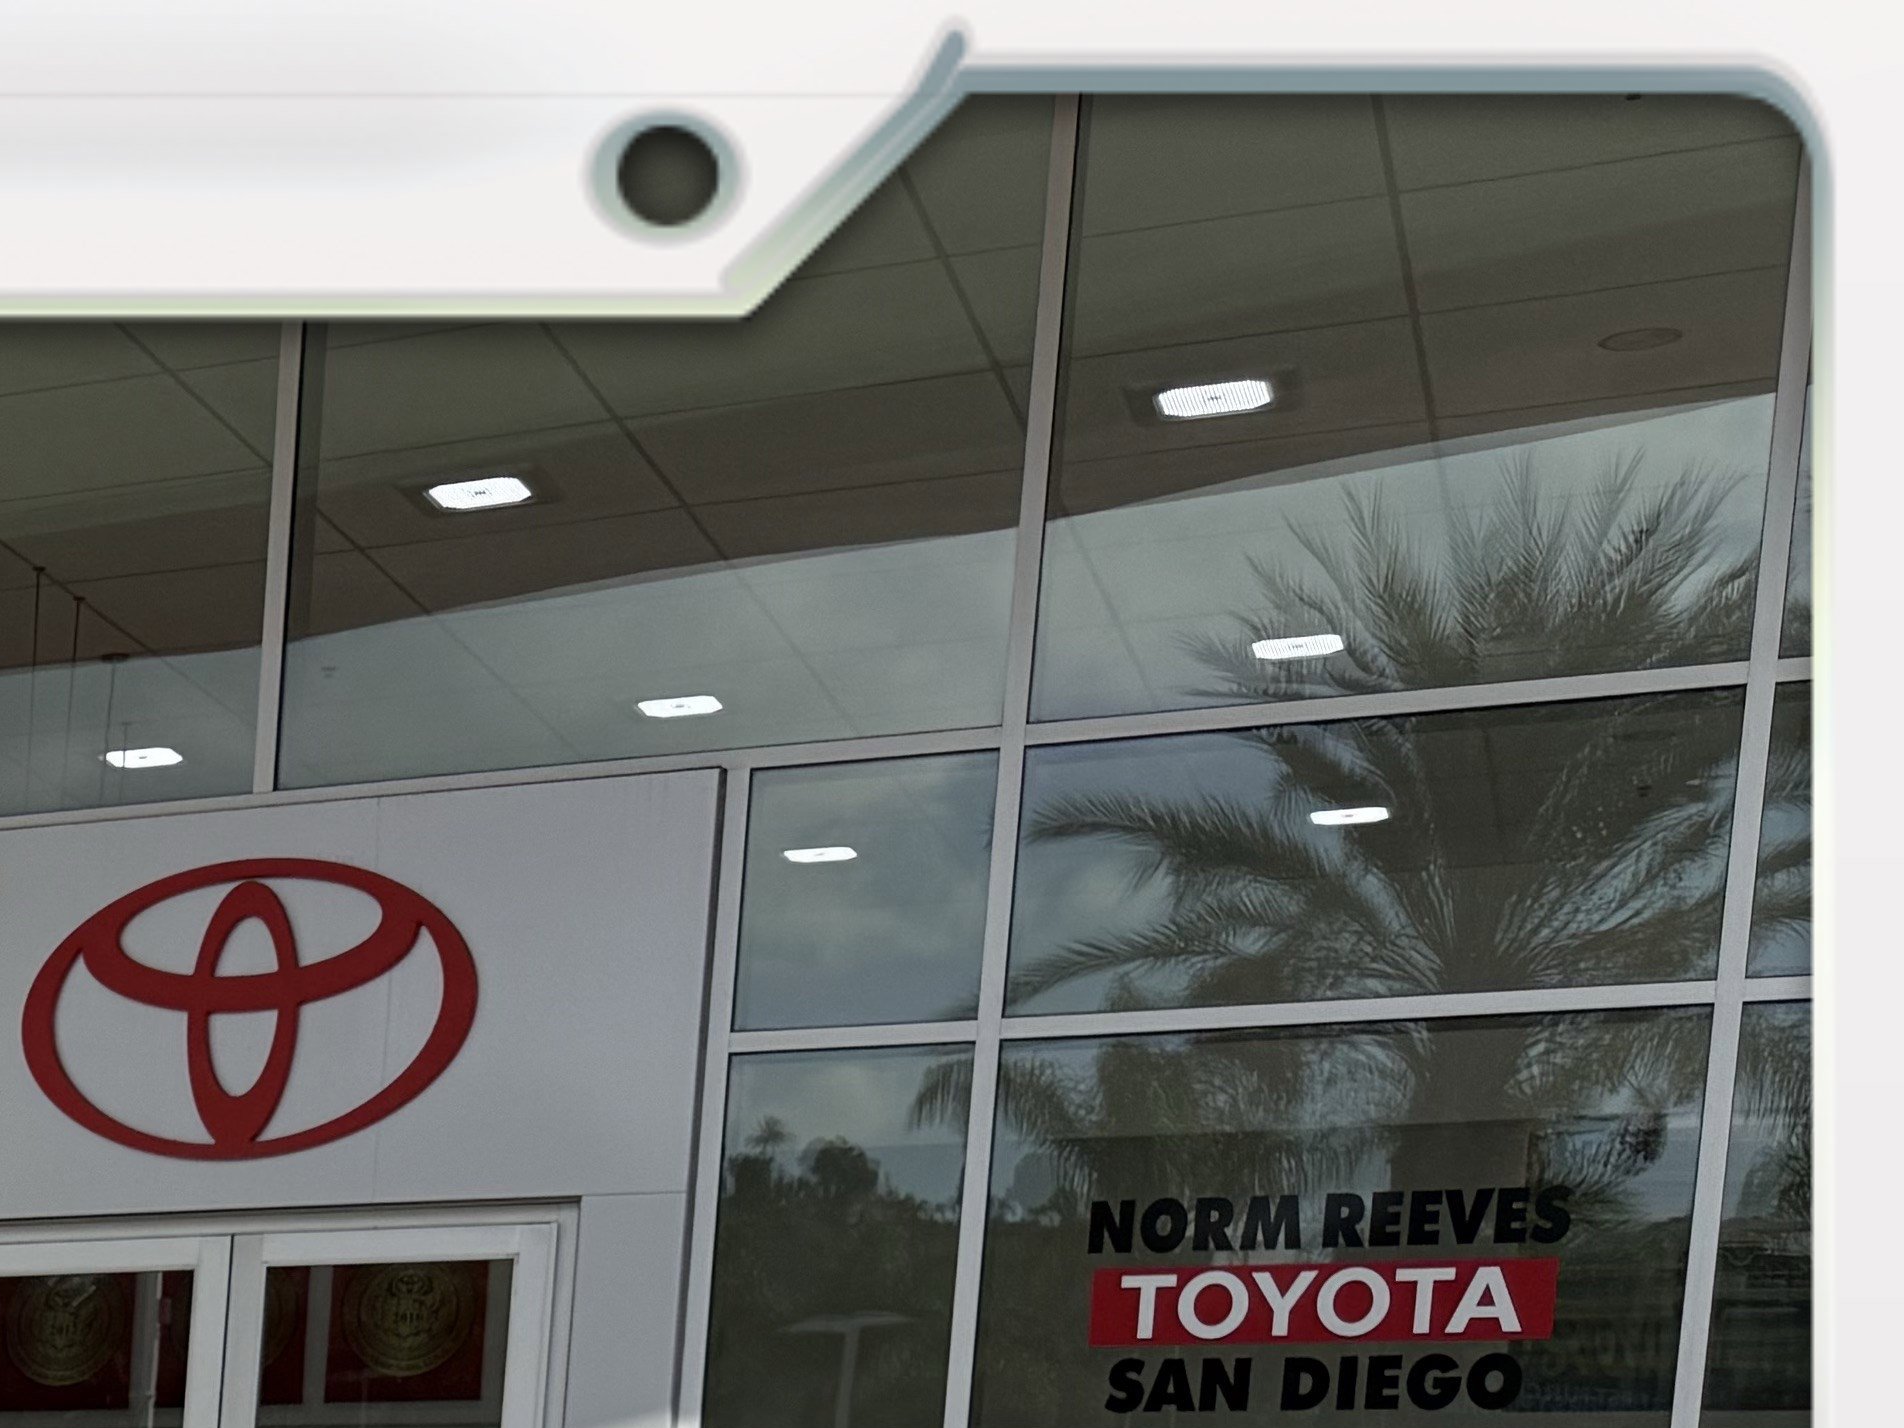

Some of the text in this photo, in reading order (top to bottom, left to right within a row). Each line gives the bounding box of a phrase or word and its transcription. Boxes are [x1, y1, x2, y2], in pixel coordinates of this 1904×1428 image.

[1087, 1185, 1577, 1254] NORM REEVES
[1120, 1265, 1522, 1339] TOYOTA
[1105, 1357, 1252, 1414] SAN
[1280, 1353, 1523, 1412] DIEGO
